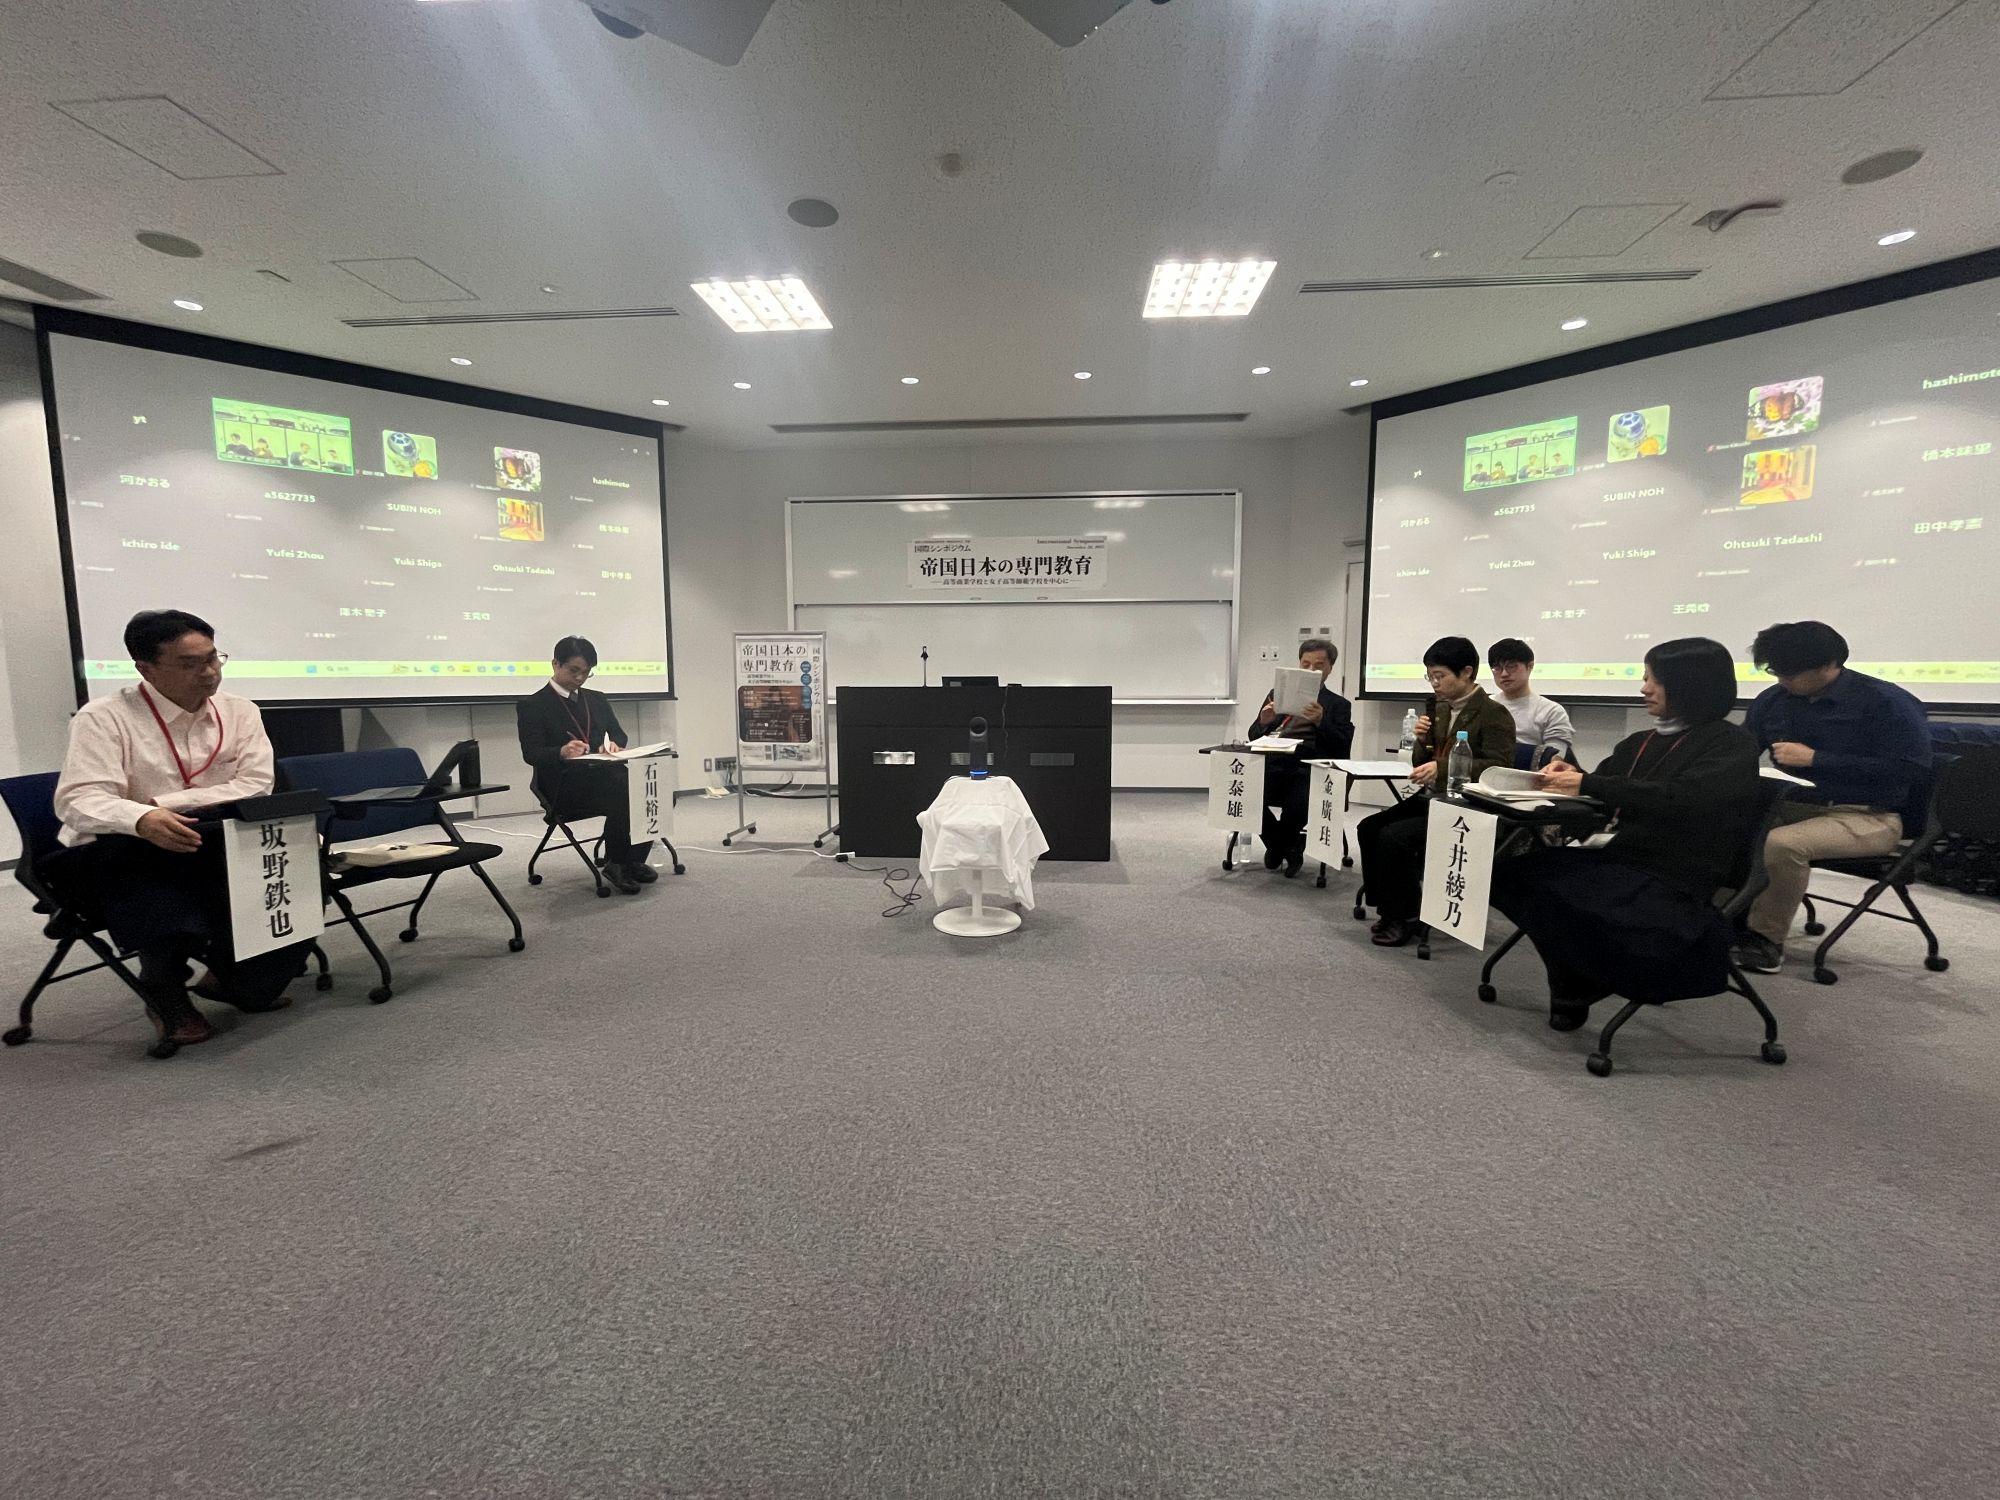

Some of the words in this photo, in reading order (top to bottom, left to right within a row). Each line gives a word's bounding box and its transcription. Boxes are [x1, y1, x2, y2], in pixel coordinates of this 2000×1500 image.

[1603, 489, 1636, 502] SUBIN
[1638, 487, 1664, 498] NOH
[387, 503, 417, 514] SUBIN
[419, 506, 442, 516] NOH
[914, 544, 971, 553] 国際シンポジウム
[1723, 537, 1770, 550] Ohtsuki
[1773, 533, 1822, 546] Tadashi
[266, 548, 295, 559] Yufei
[297, 550, 324, 561] Zhou
[1602, 551, 1624, 561] Yuki
[1626, 548, 1656, 559] Shiga
[394, 557, 415, 567] Yuki
[920, 555, 1092, 577] 帝国日本の専門教育
[492, 563, 523, 574] Ohtsuki
[526, 566, 555, 576] Tadashi
[742, 643, 806, 657] 帝国日本の
[743, 658, 794, 672] 専門教育
[1226, 758, 1245, 818] 金泰雄
[644, 762, 659, 835] 石川裕之
[1443, 815, 1471, 928] 今井綾乃
[258, 821, 294, 939] 坂野鉄也
